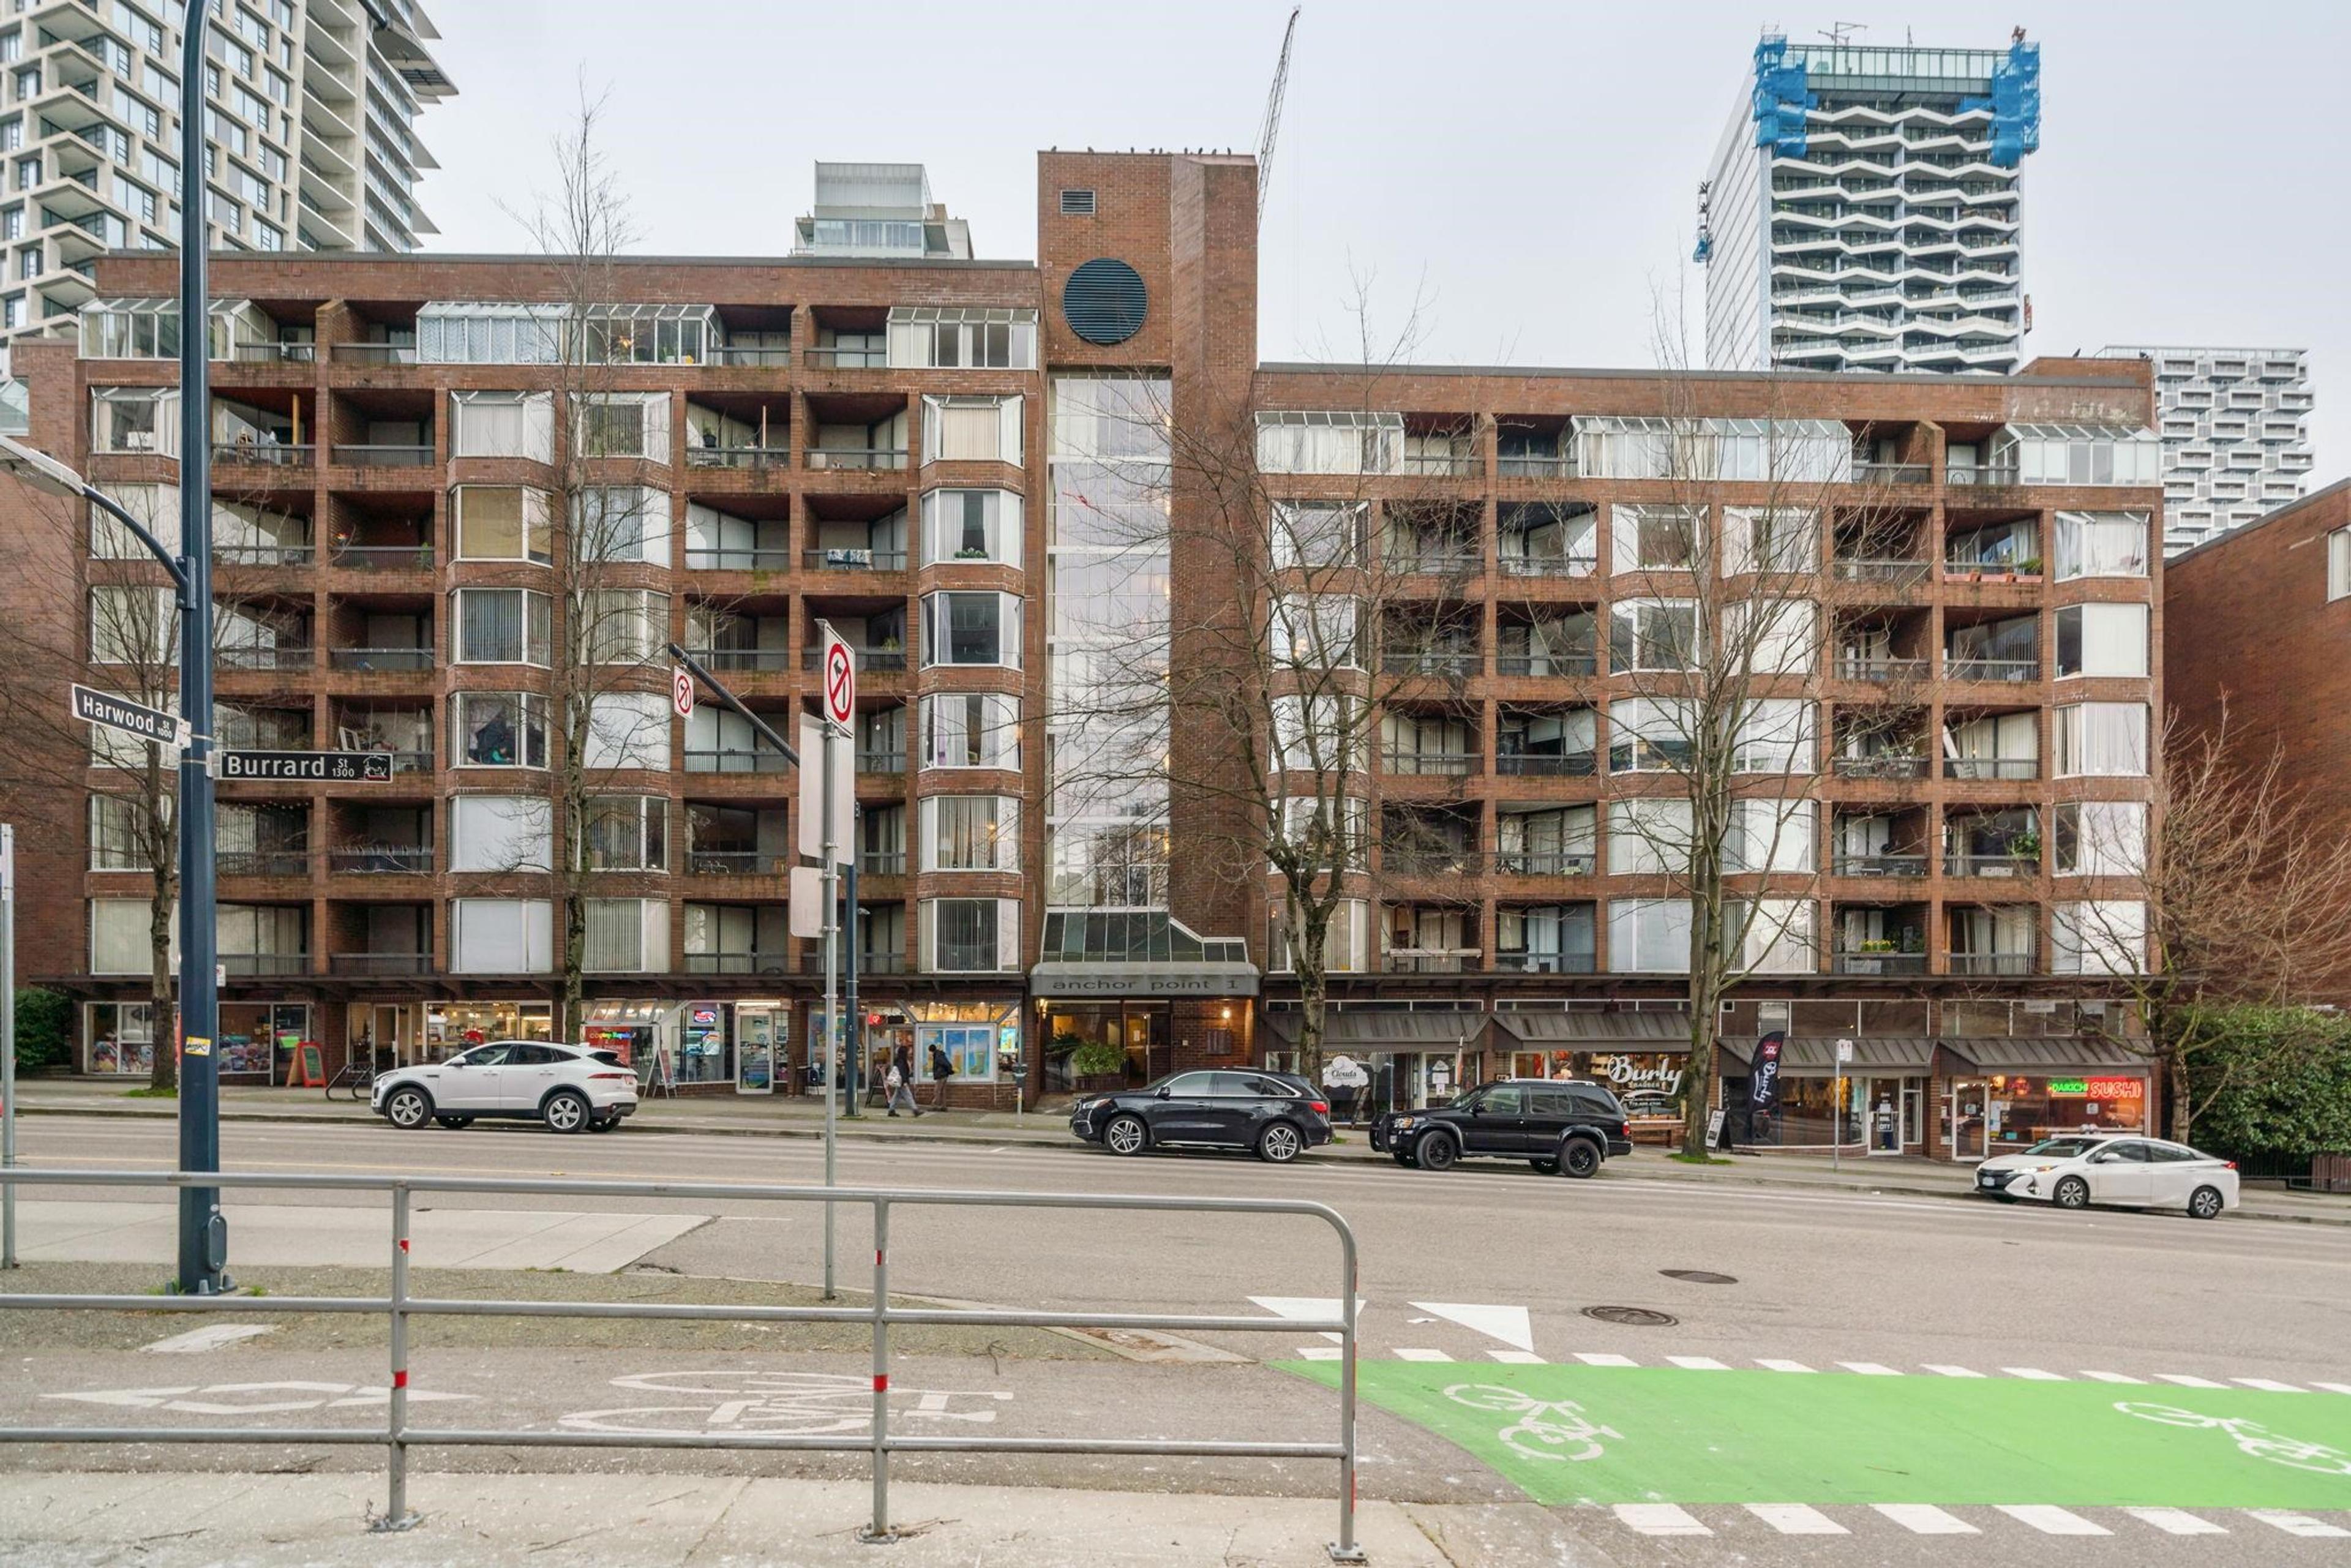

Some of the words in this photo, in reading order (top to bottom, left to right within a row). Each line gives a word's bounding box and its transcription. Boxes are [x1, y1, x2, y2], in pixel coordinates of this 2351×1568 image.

[83, 694, 154, 733] Harwood
[227, 755, 325, 776] Burrard
[337, 758, 348, 768] St
[331, 768, 355, 778] 1300
[1052, 980, 1137, 989] anchor
[1150, 980, 1211, 991] point
[1607, 1056, 1683, 1096] Burly
[2090, 1081, 2142, 1098] SUSHI
